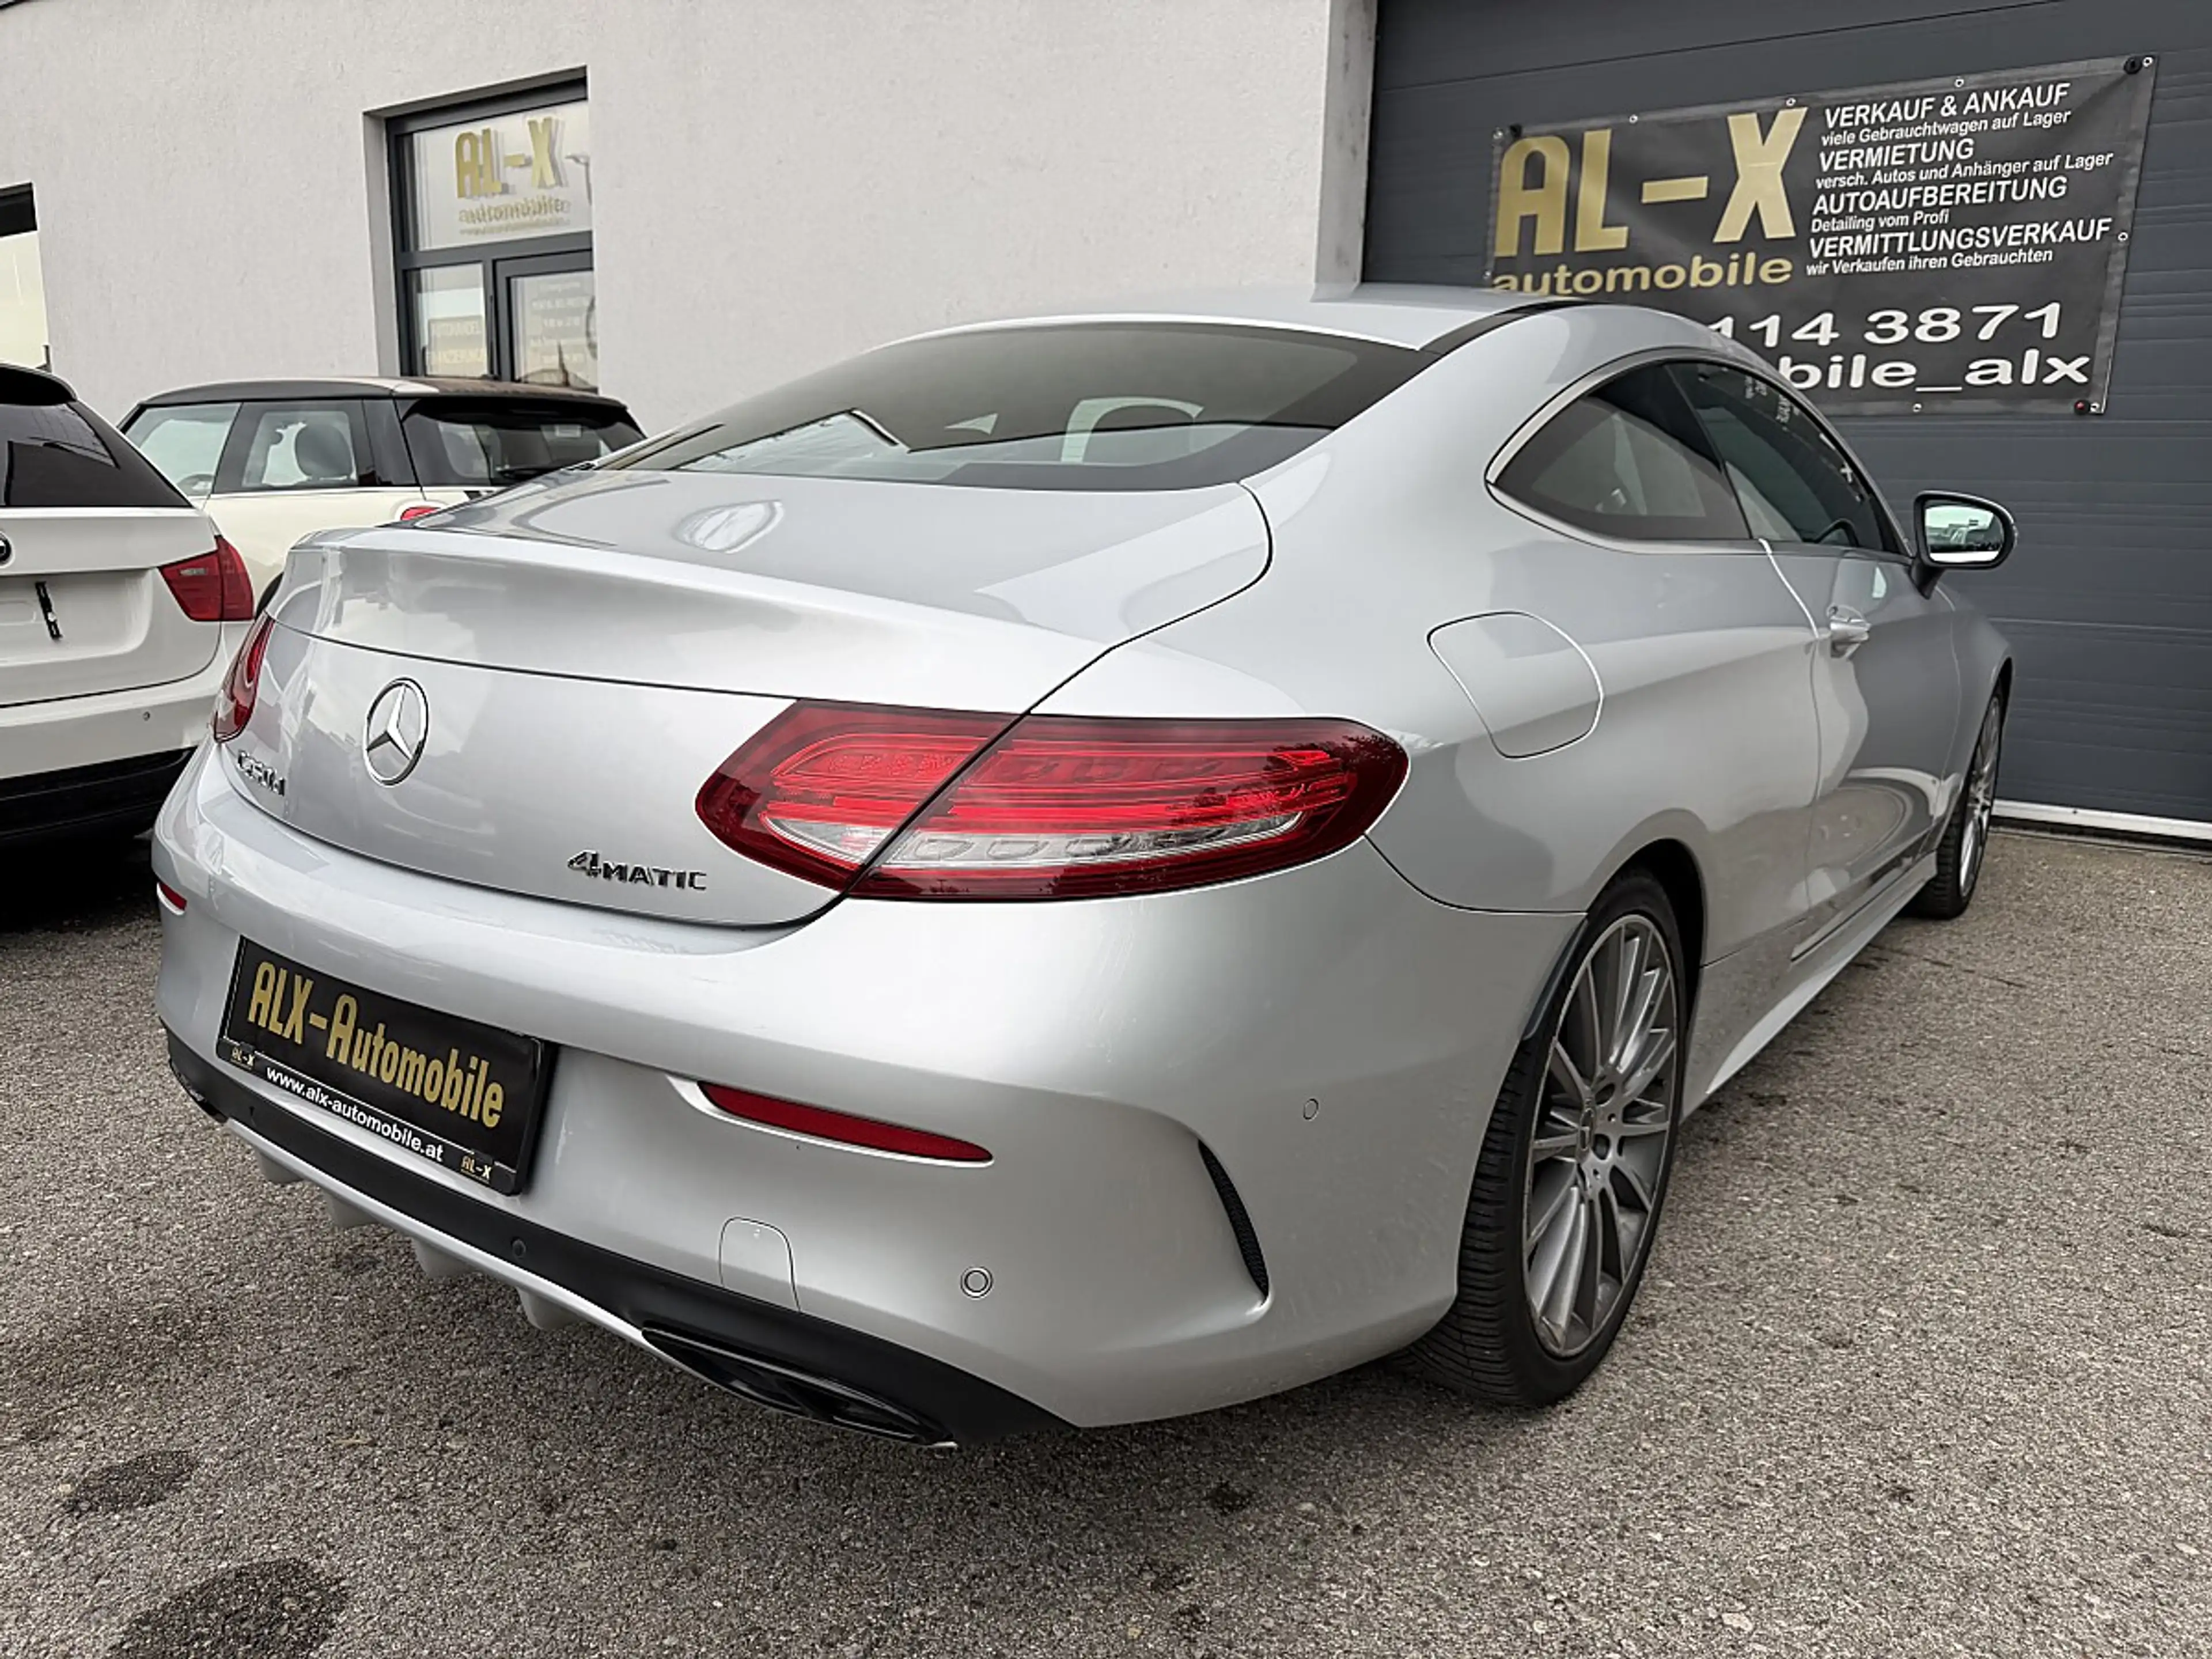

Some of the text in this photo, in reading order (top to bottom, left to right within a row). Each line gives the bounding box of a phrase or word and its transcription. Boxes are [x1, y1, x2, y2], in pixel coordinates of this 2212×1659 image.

[1824, 82, 2070, 129] VERKAUF & ANKAUF
[1821, 110, 2071, 147] viele Gebrauchtwagen auf Lager
[454, 116, 556, 199] AL-X
[1816, 152, 2114, 189] versch. Autos und Anhänger auf Lager
[1819, 138, 1975, 173] VERMIETUNG
[1494, 107, 1809, 257] AL-X
[1812, 175, 2067, 215] AUTOAUFBEREITUNG
[1809, 217, 2113, 259] VERMITTLUNGSVERKAUF
[1811, 209, 1950, 233] Detailing vom Profi
[1492, 252, 1793, 297] automobile
[1806, 248, 2054, 276] wir Verkaufen ihren Gebrauchten
[1863, 302, 2062, 344] 3871
[567, 849, 707, 891] 4MATIC
[248, 961, 505, 1128] ALX-Automobile
[266, 1066, 444, 1162] www.alx-automobile.at
[461, 1155, 491, 1180] AL-X
